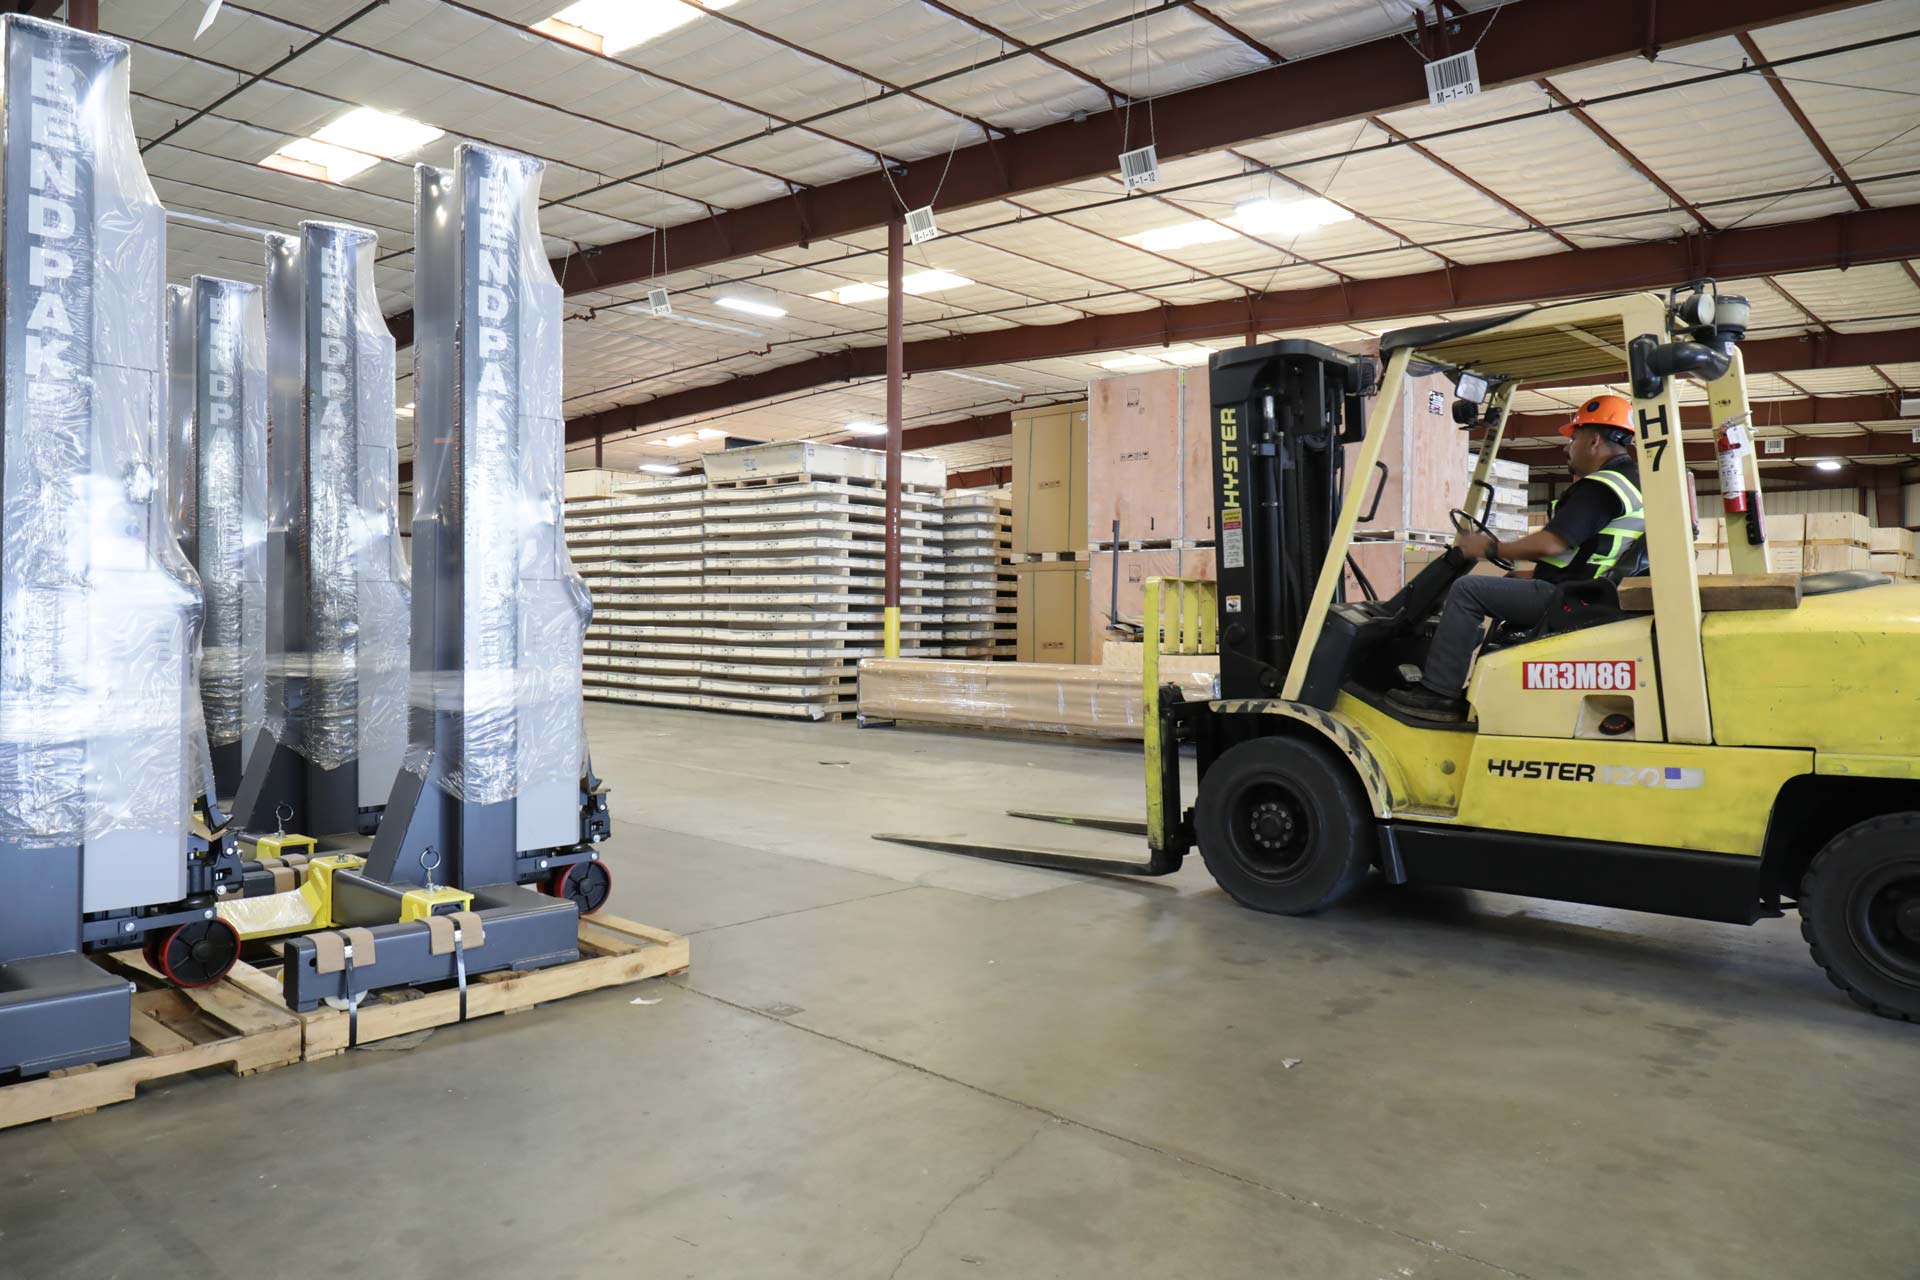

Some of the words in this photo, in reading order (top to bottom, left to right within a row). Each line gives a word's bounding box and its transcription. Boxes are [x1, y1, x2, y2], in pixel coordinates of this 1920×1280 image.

[1437, 82, 1474, 104] M-1-10
[26, 56, 77, 379] BENDPAK
[1220, 407, 1241, 508] HYSTER
[1527, 662, 1632, 689] KR3M86
[1487, 758, 1596, 783] HYSTER
